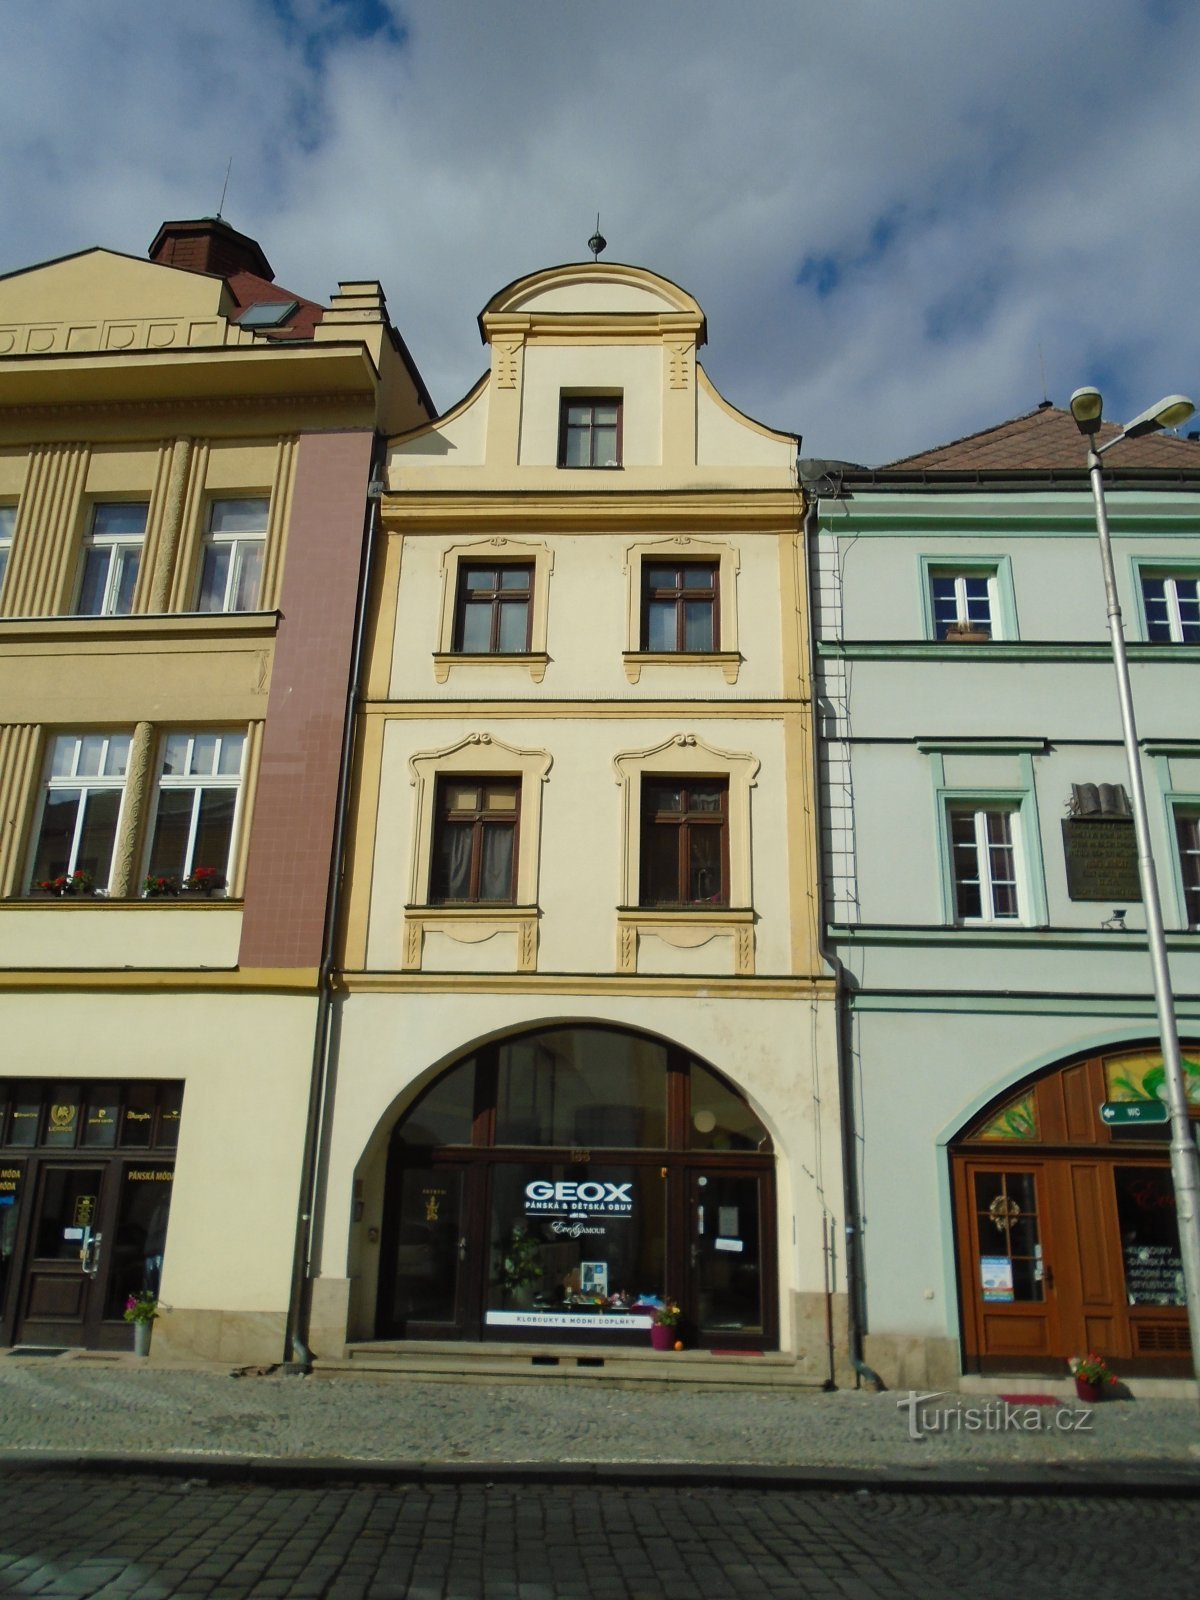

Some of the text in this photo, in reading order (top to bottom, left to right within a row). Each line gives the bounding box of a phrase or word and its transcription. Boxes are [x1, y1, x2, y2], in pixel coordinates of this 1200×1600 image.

[1127, 1107, 1141, 1117] WC
[128, 1170, 154, 1181] PÁNSKÁ
[525, 1181, 632, 1202] GEOX
[525, 1200, 560, 1209] PÁNSKÁ
[571, 1201, 605, 1210] DĚTSKÁ
[517, 1316, 559, 1324] KLOBOUKY
